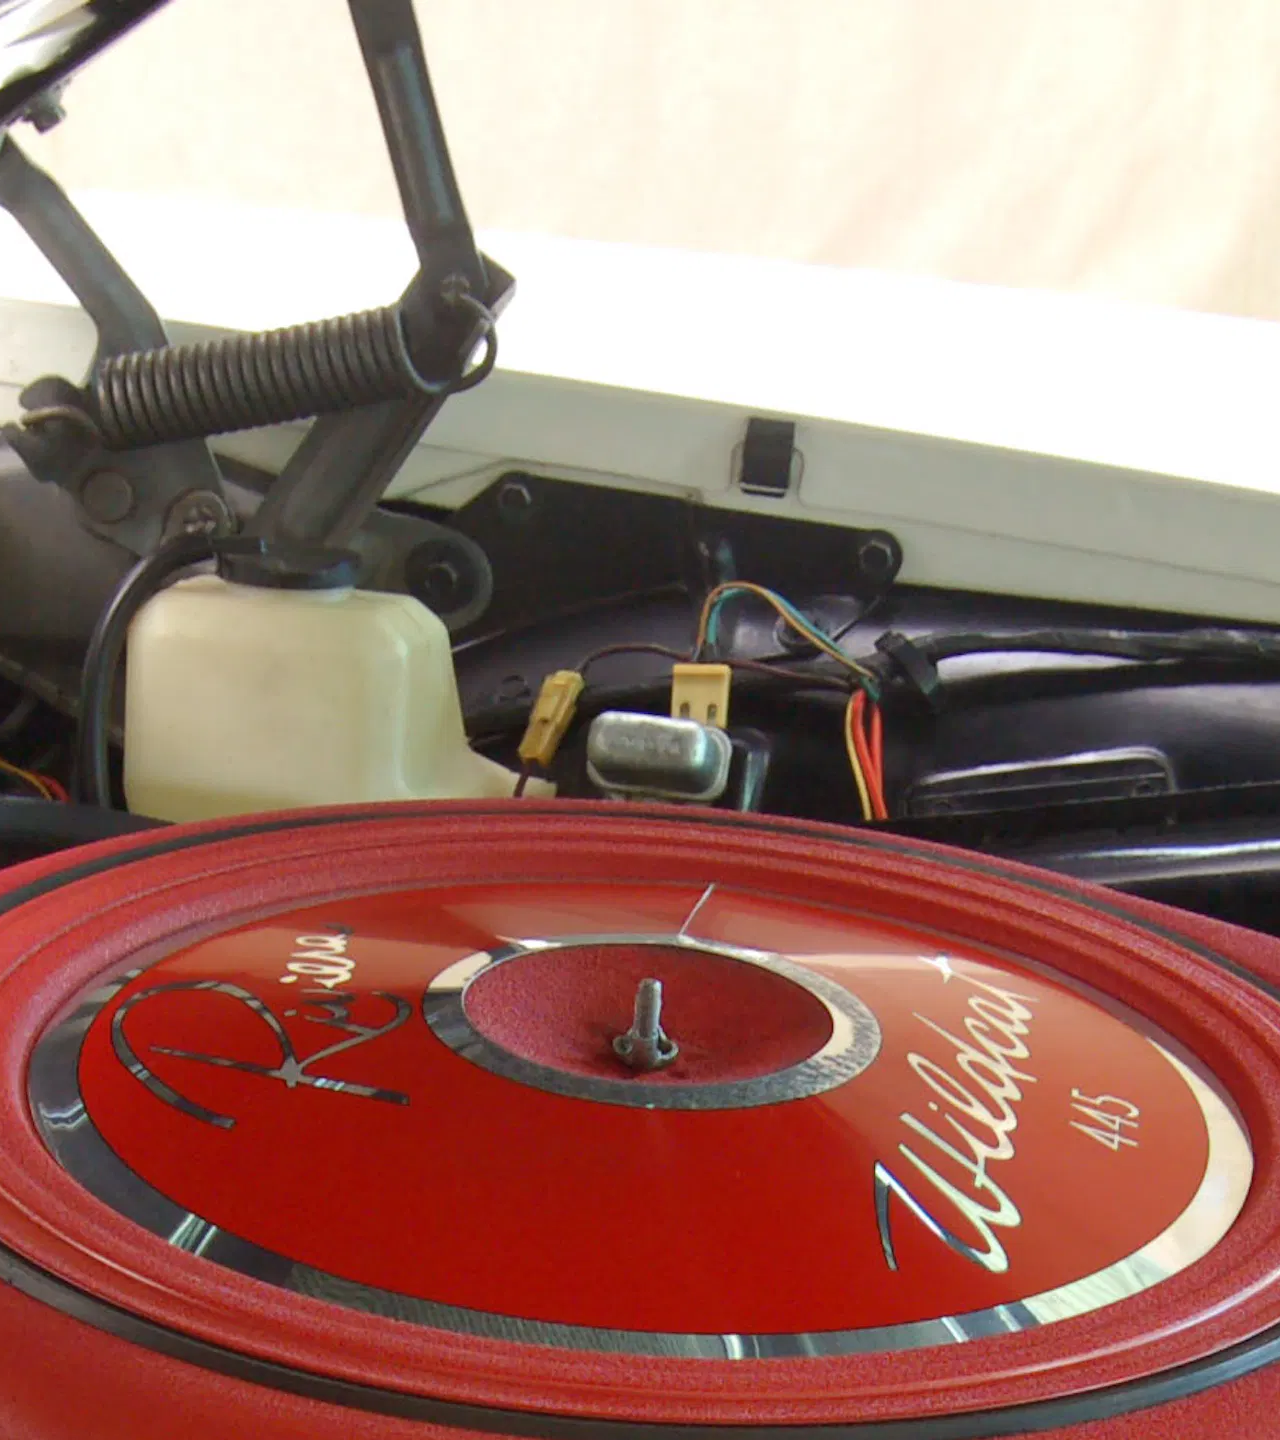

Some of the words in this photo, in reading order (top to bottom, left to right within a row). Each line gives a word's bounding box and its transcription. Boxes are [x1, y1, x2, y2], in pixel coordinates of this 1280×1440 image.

[111, 923, 412, 1131] Riviera
[874, 954, 1039, 1275] Wildcat
[1069, 1087, 1140, 1151] 445
